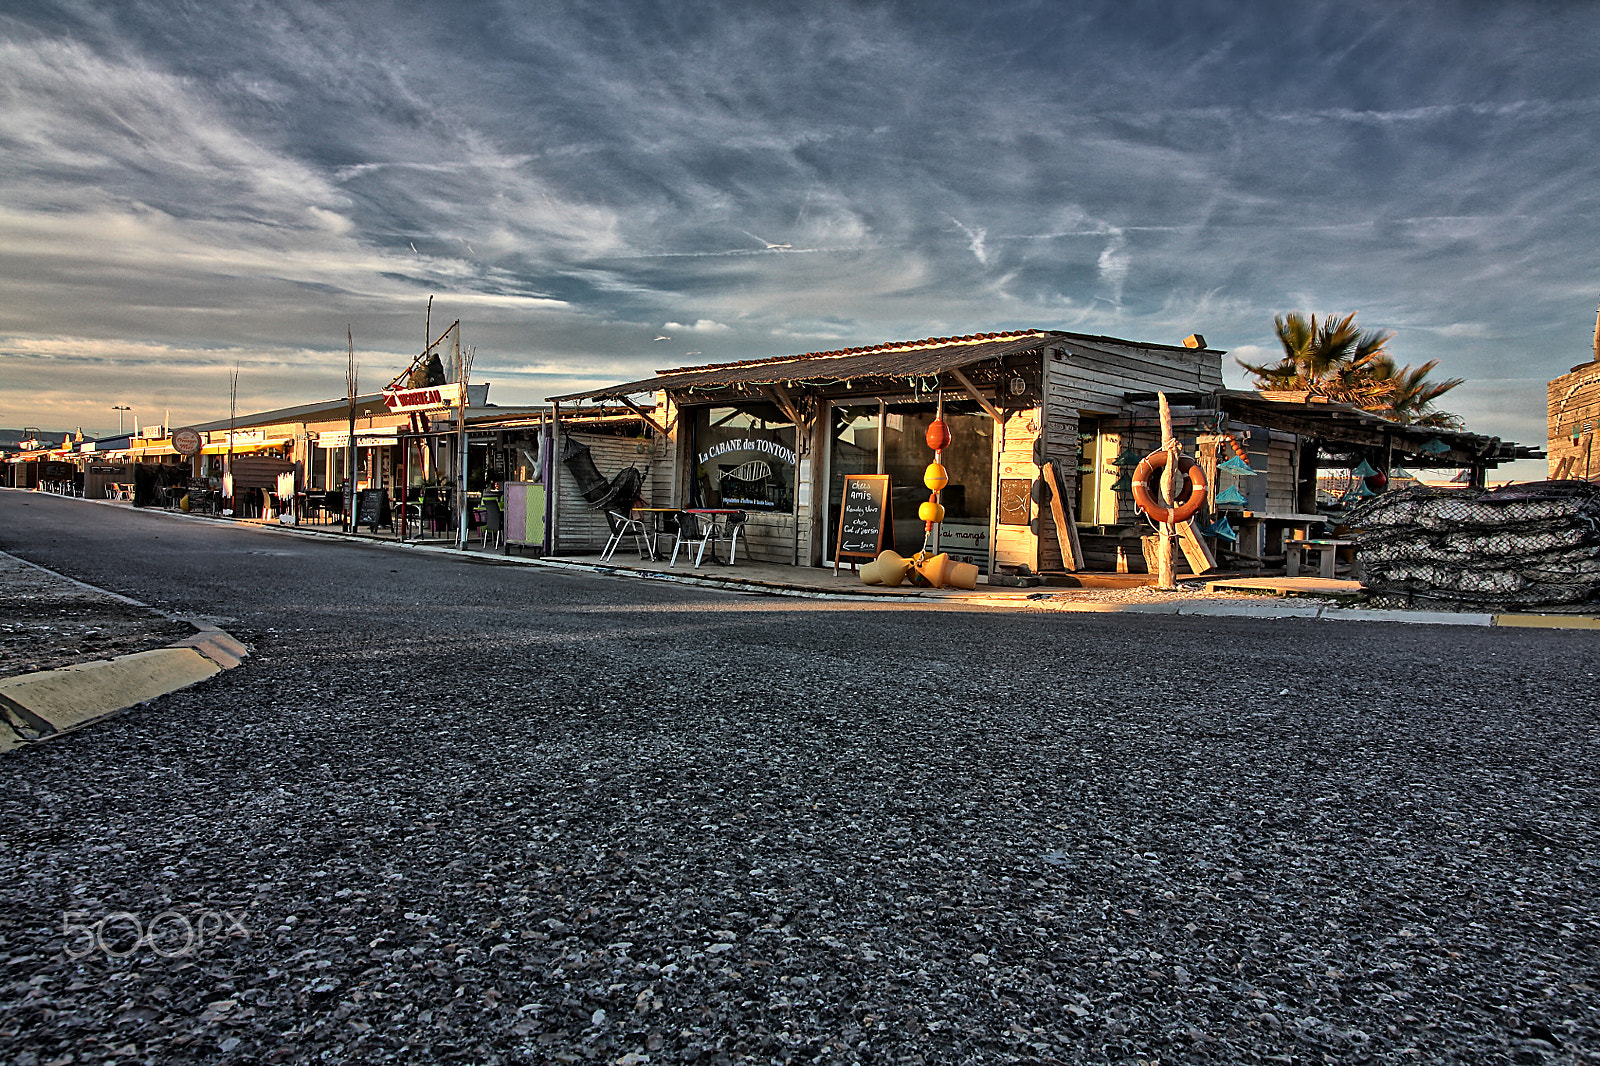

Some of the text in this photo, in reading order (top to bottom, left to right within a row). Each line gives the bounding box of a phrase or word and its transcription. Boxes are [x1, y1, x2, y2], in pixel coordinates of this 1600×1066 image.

[698, 438, 796, 465] La CABANE des TONTONS
[955, 531, 985, 546] mangé
